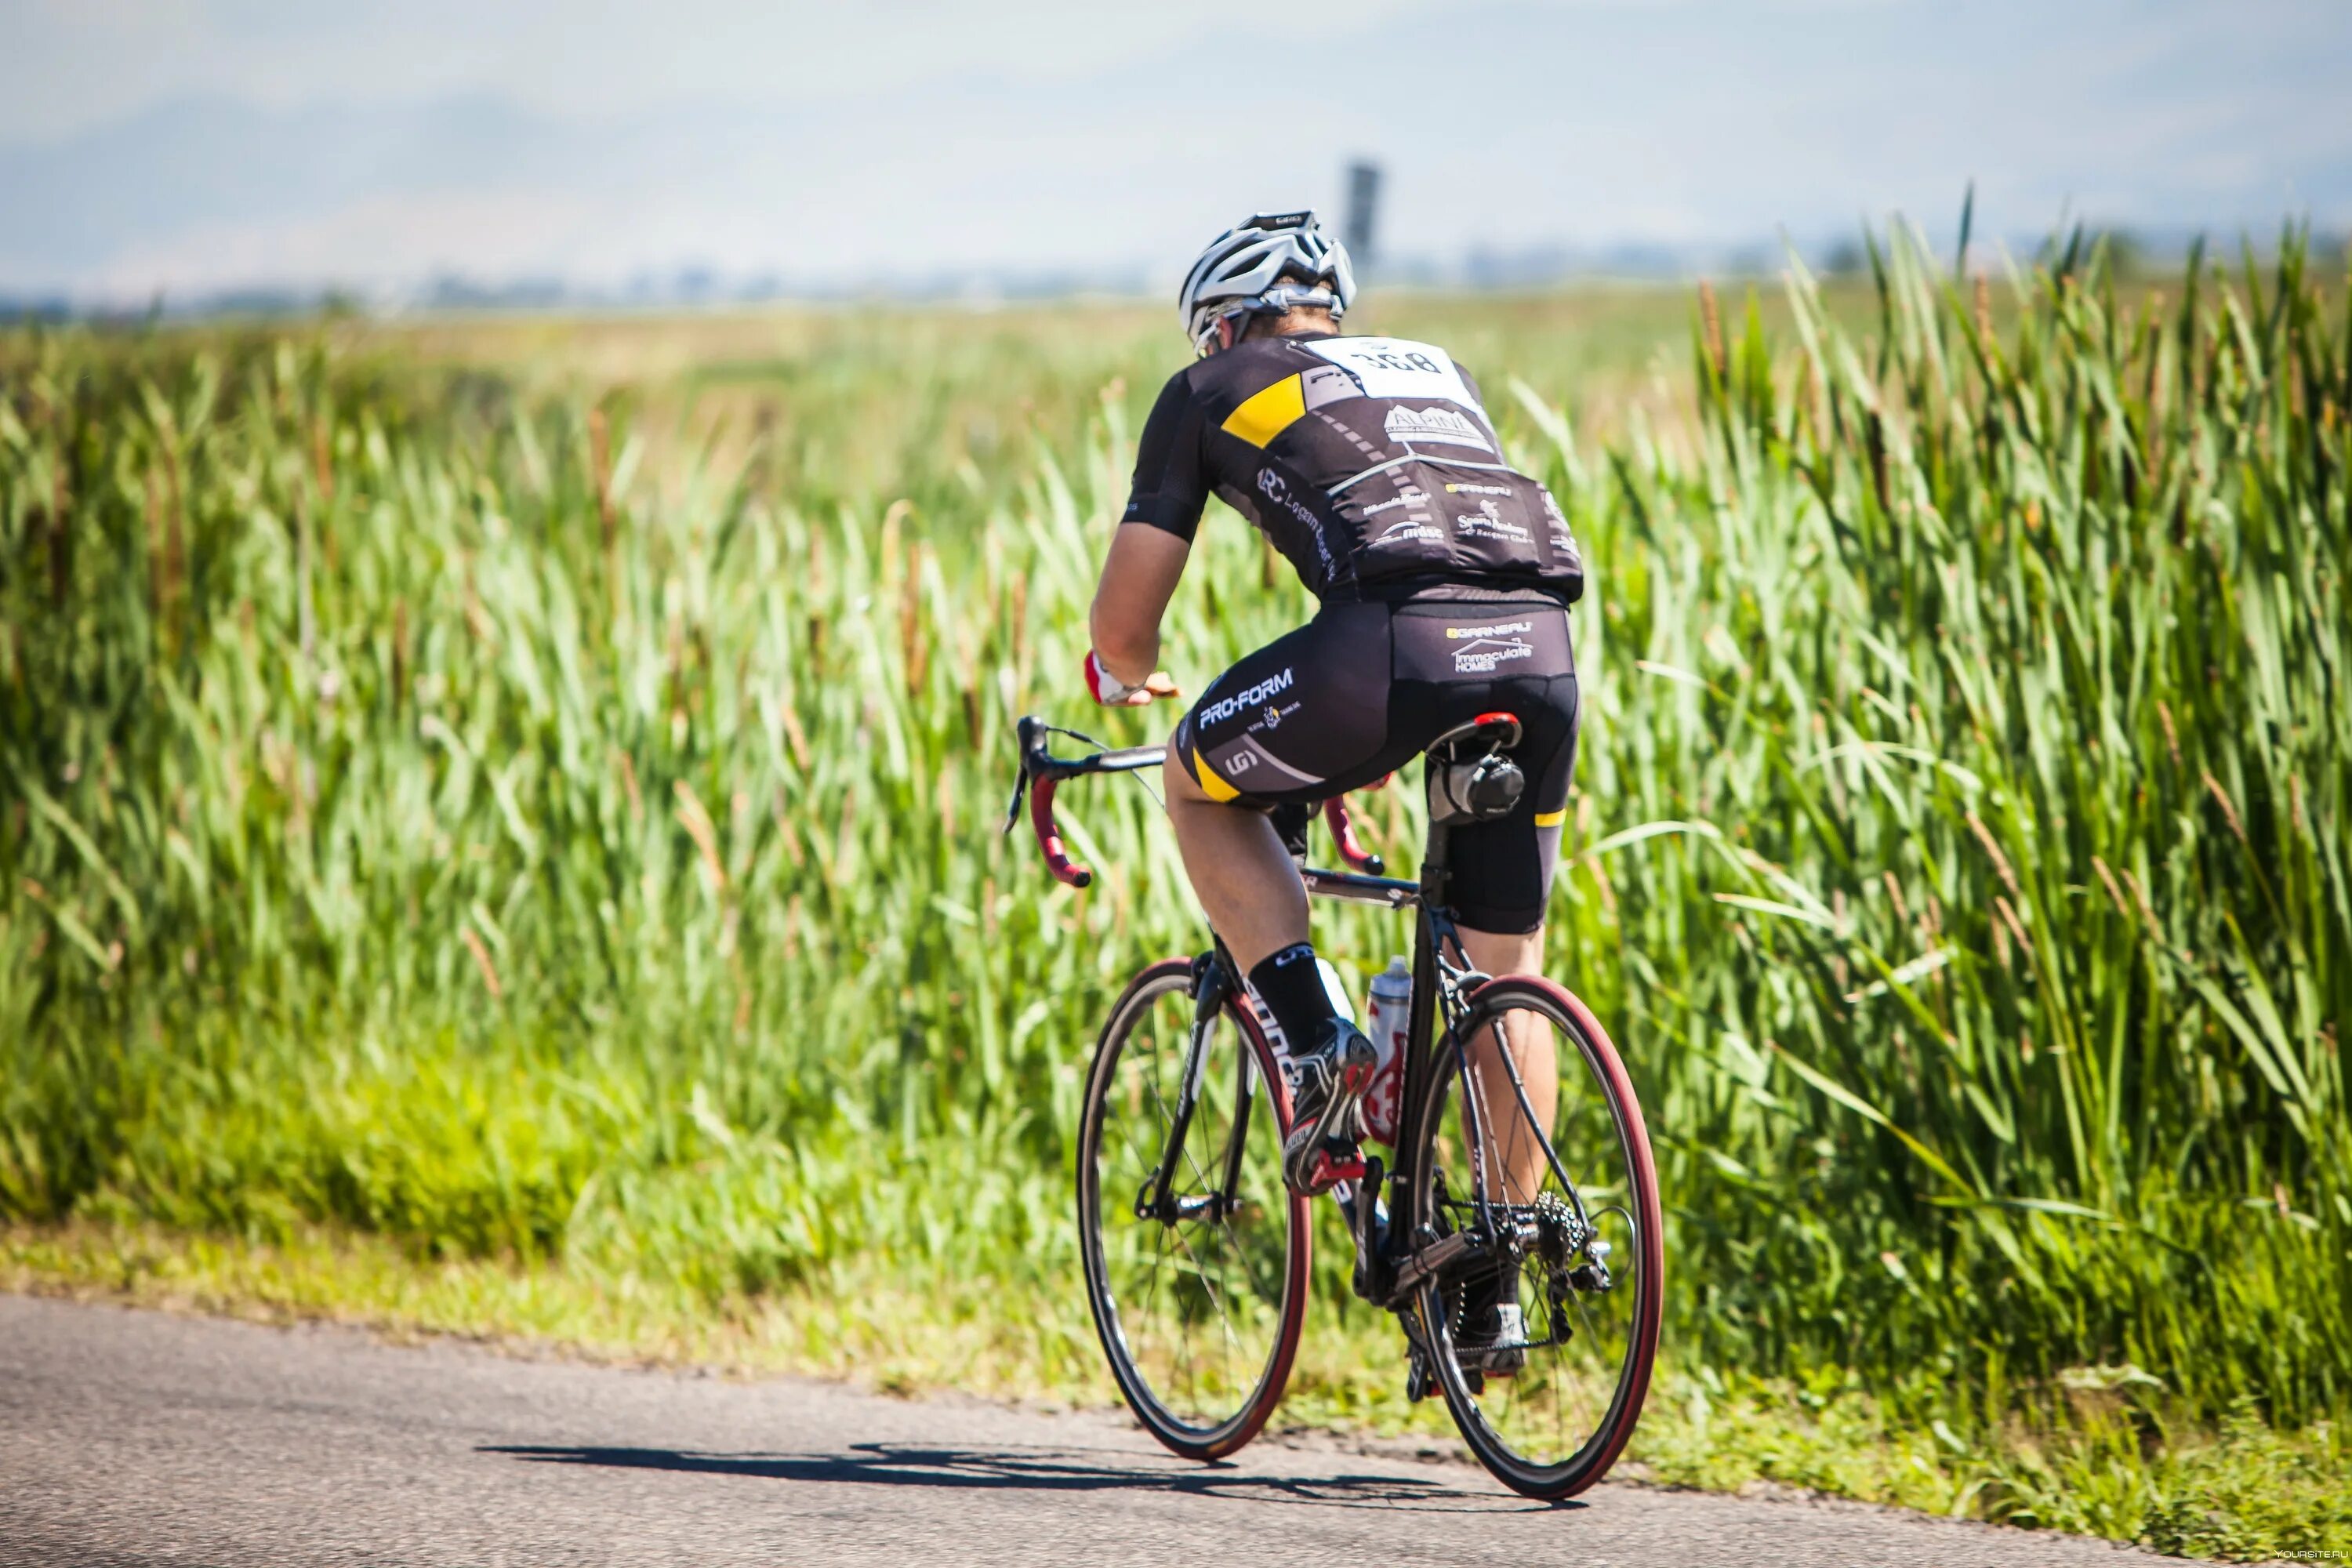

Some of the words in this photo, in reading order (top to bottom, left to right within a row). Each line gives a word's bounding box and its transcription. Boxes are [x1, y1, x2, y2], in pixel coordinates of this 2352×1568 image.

[1457, 622, 1532, 638] GARNEAU
[1455, 660, 1496, 673] HOMES
[1200, 667, 1294, 731] PRO-FORM
